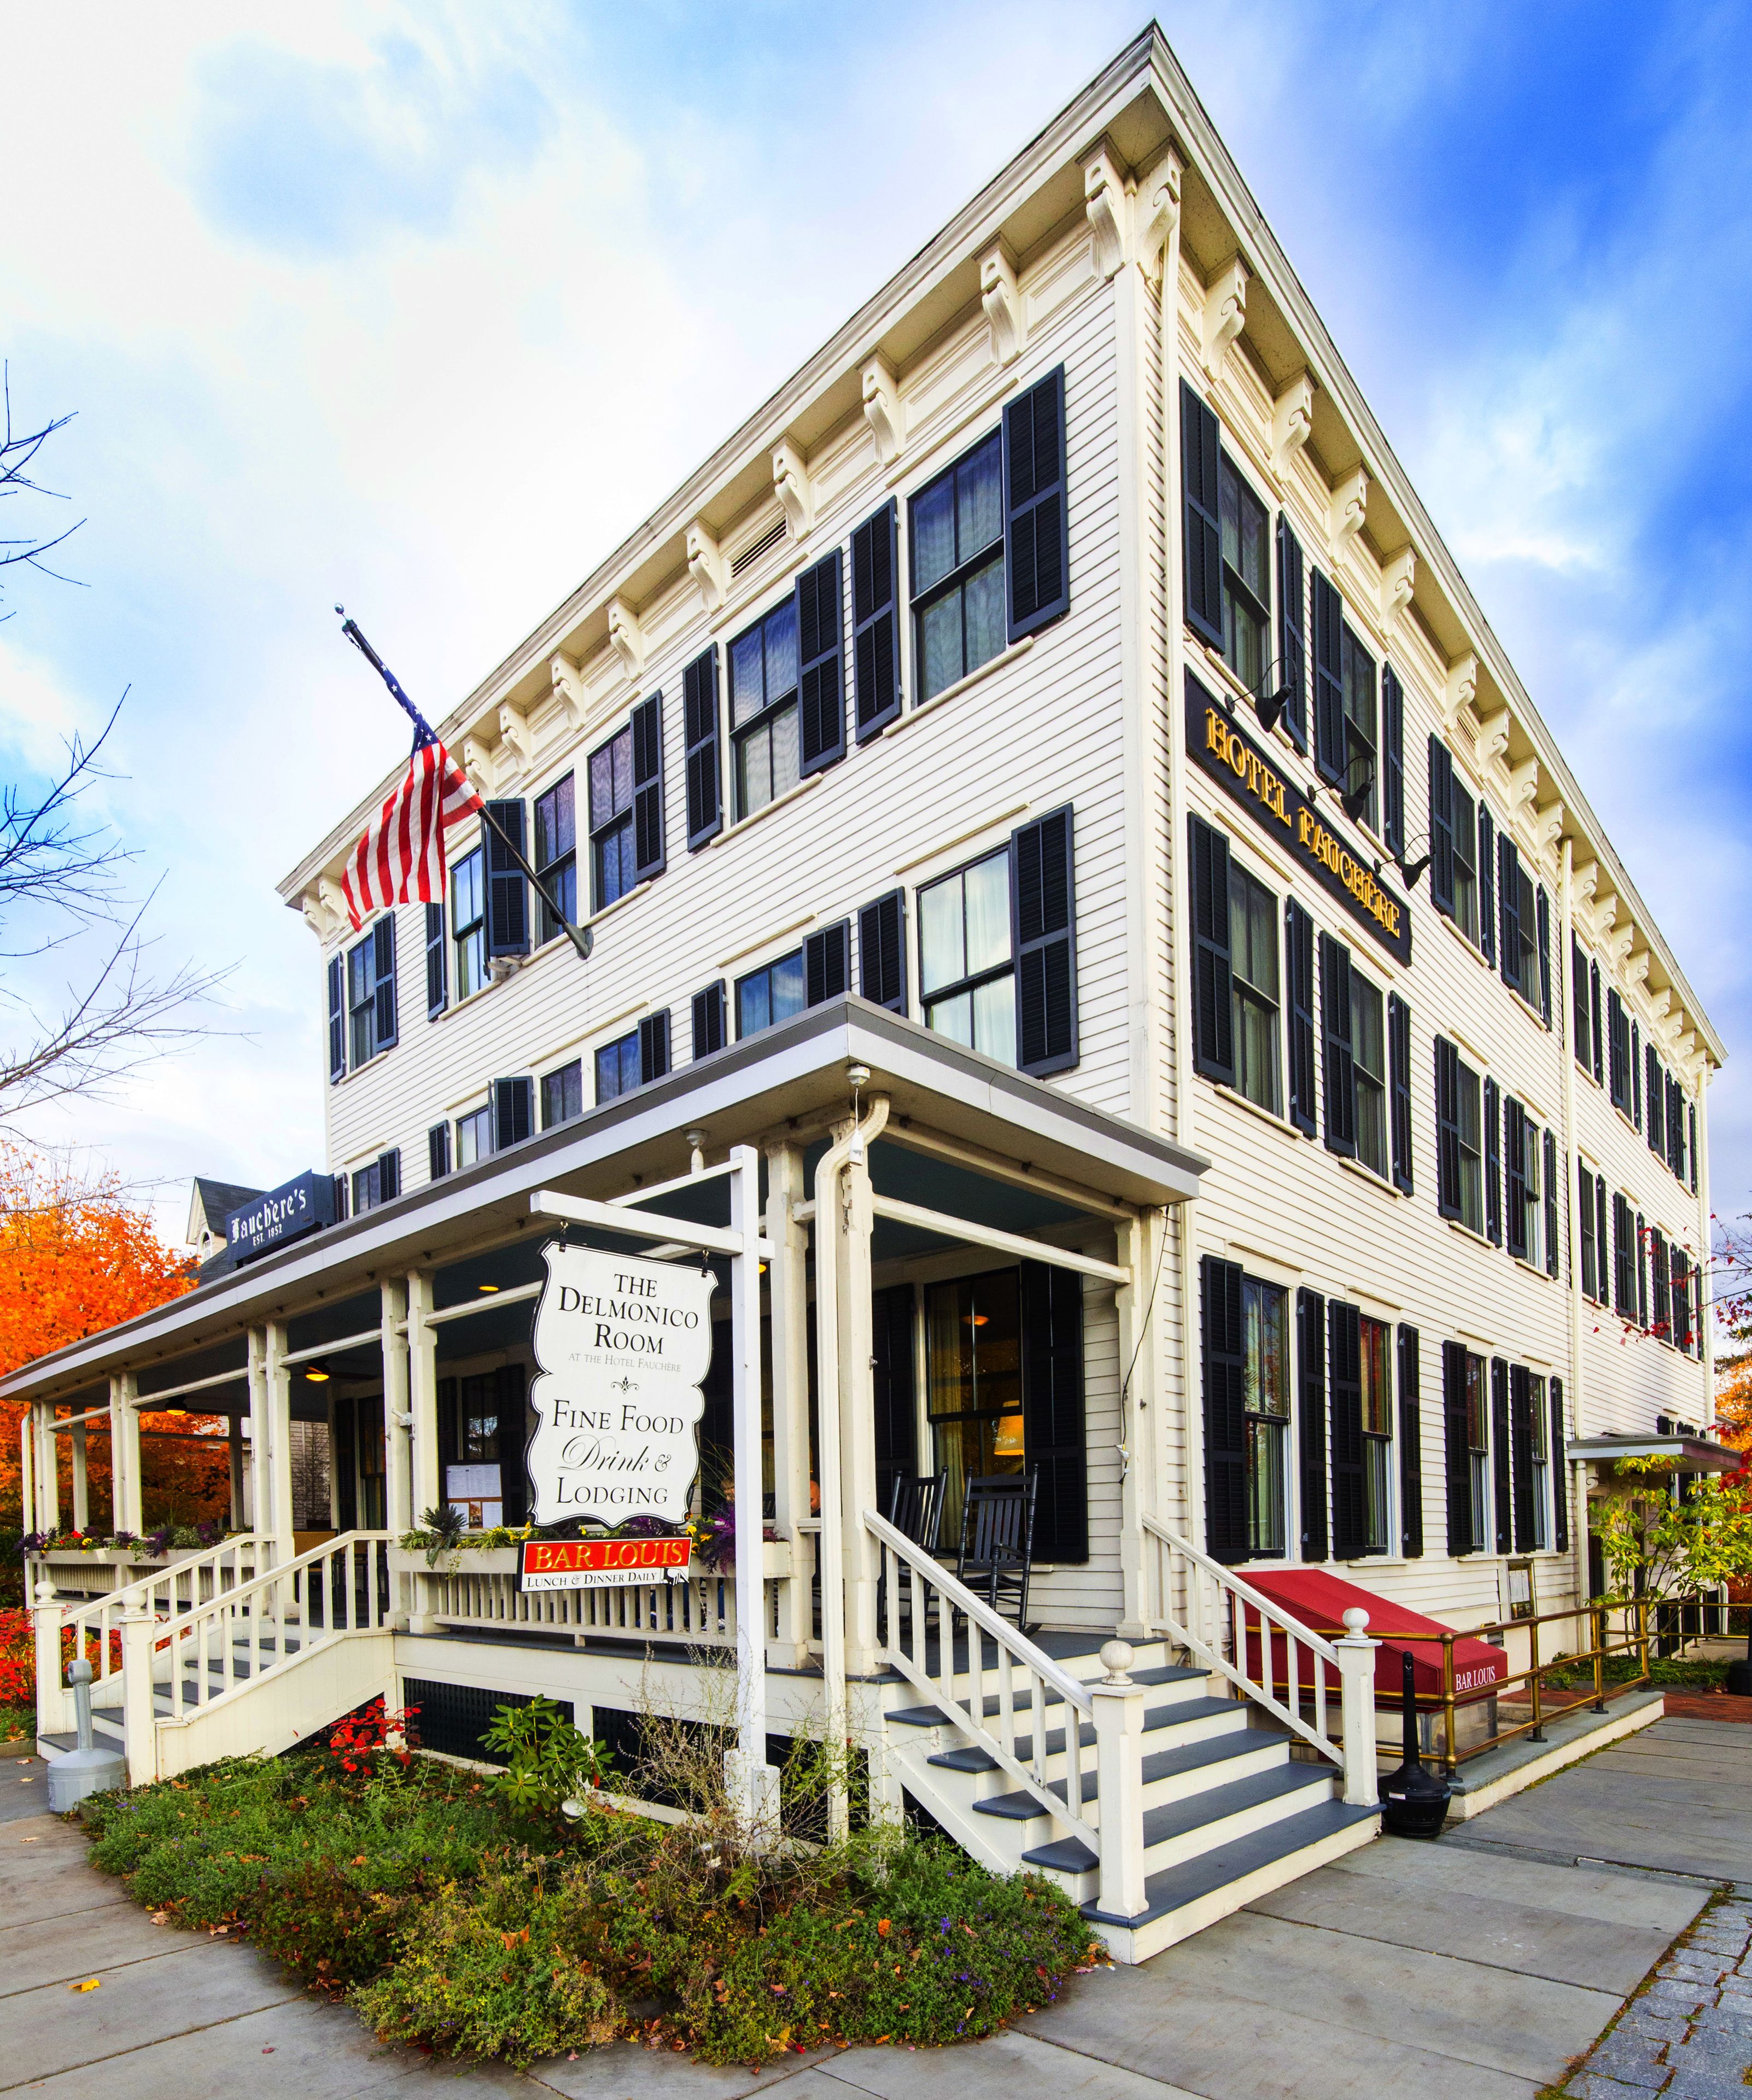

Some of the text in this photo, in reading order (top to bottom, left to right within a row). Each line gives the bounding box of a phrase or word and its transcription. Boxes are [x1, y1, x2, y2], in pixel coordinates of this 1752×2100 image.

[1206, 708, 1400, 939] HOTEL FAUCHÈRE
[253, 1223, 283, 1246] EST. 1852
[614, 1273, 657, 1298] THE
[558, 1286, 698, 1329] DELMONICO
[594, 1323, 664, 1355] ROOM
[568, 1352, 581, 1361] AT
[585, 1354, 601, 1364] THE
[604, 1355, 635, 1368] HOTEL
[552, 1399, 684, 1434] FINE FOOD
[557, 1433, 672, 1472] Drink &
[556, 1477, 668, 1504] LODGING
[534, 1542, 683, 1570] BAR LOUIS
[527, 1571, 657, 1588] LUNCH & DINNER DAILY
[1455, 1666, 1496, 1691] BAR LOUIS
